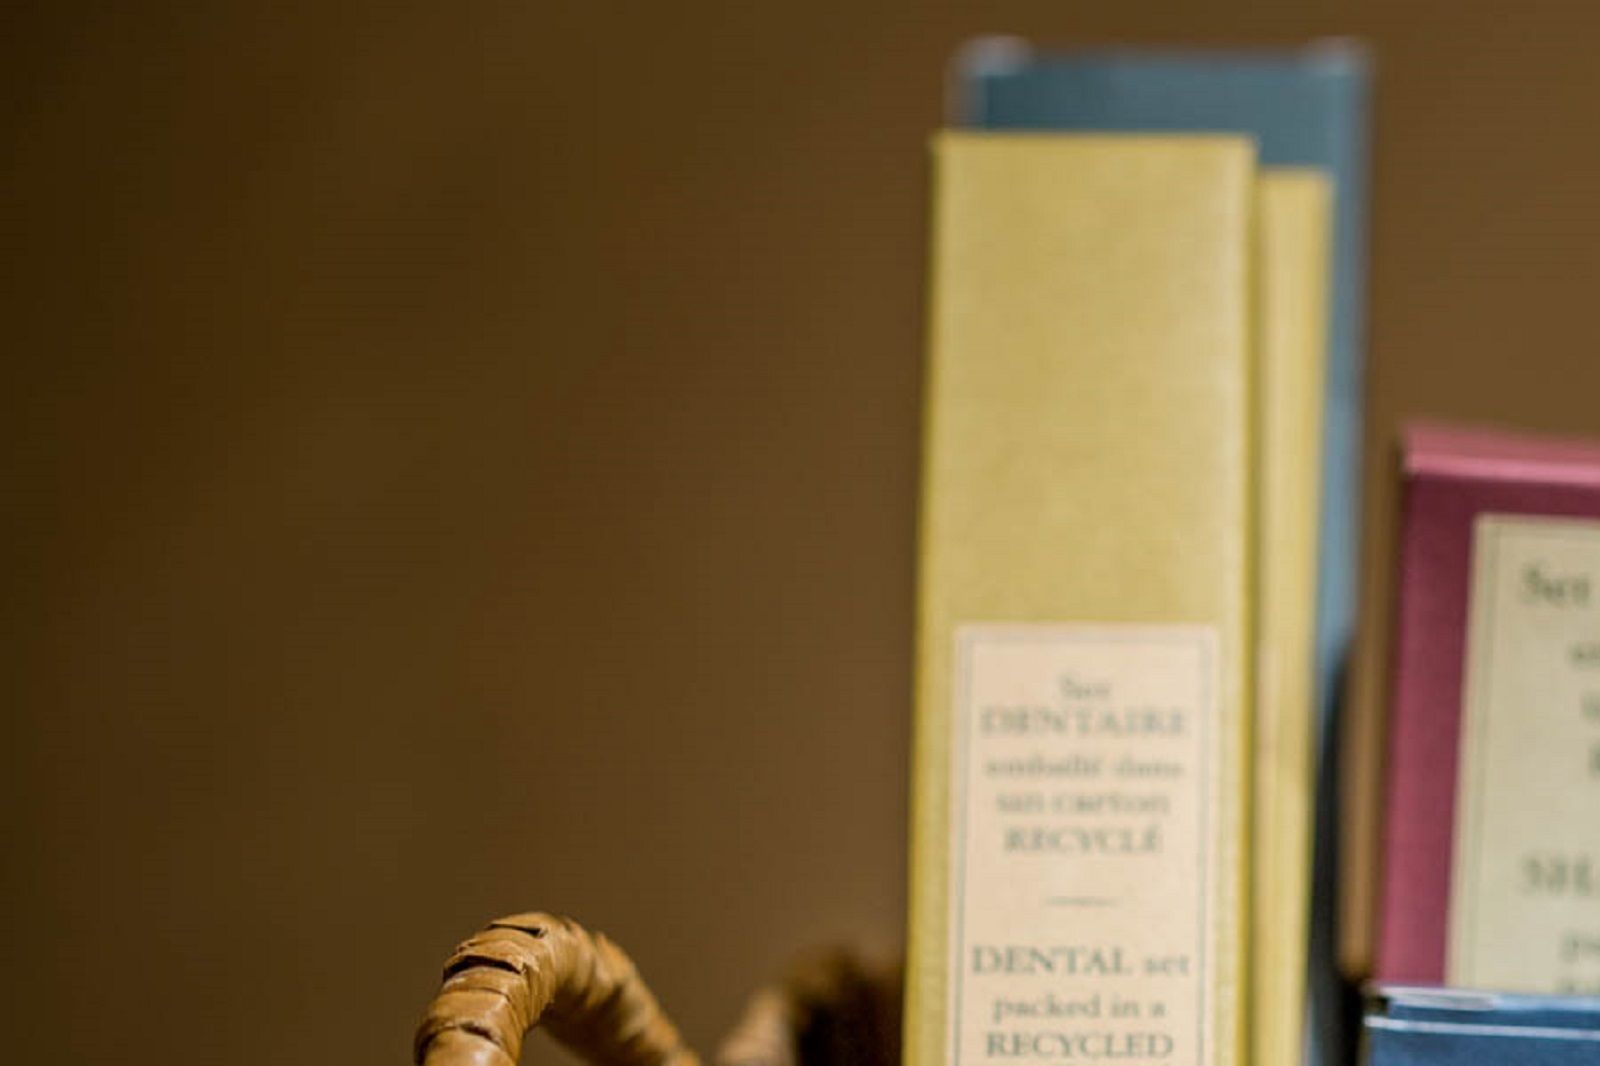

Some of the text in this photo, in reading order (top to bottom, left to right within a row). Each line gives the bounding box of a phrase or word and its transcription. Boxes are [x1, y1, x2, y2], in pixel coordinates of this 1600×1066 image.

[971, 945, 1190, 976] DENTAL set
[993, 993, 1167, 1023] packed in a
[985, 1031, 1175, 1058] RECYCLED
